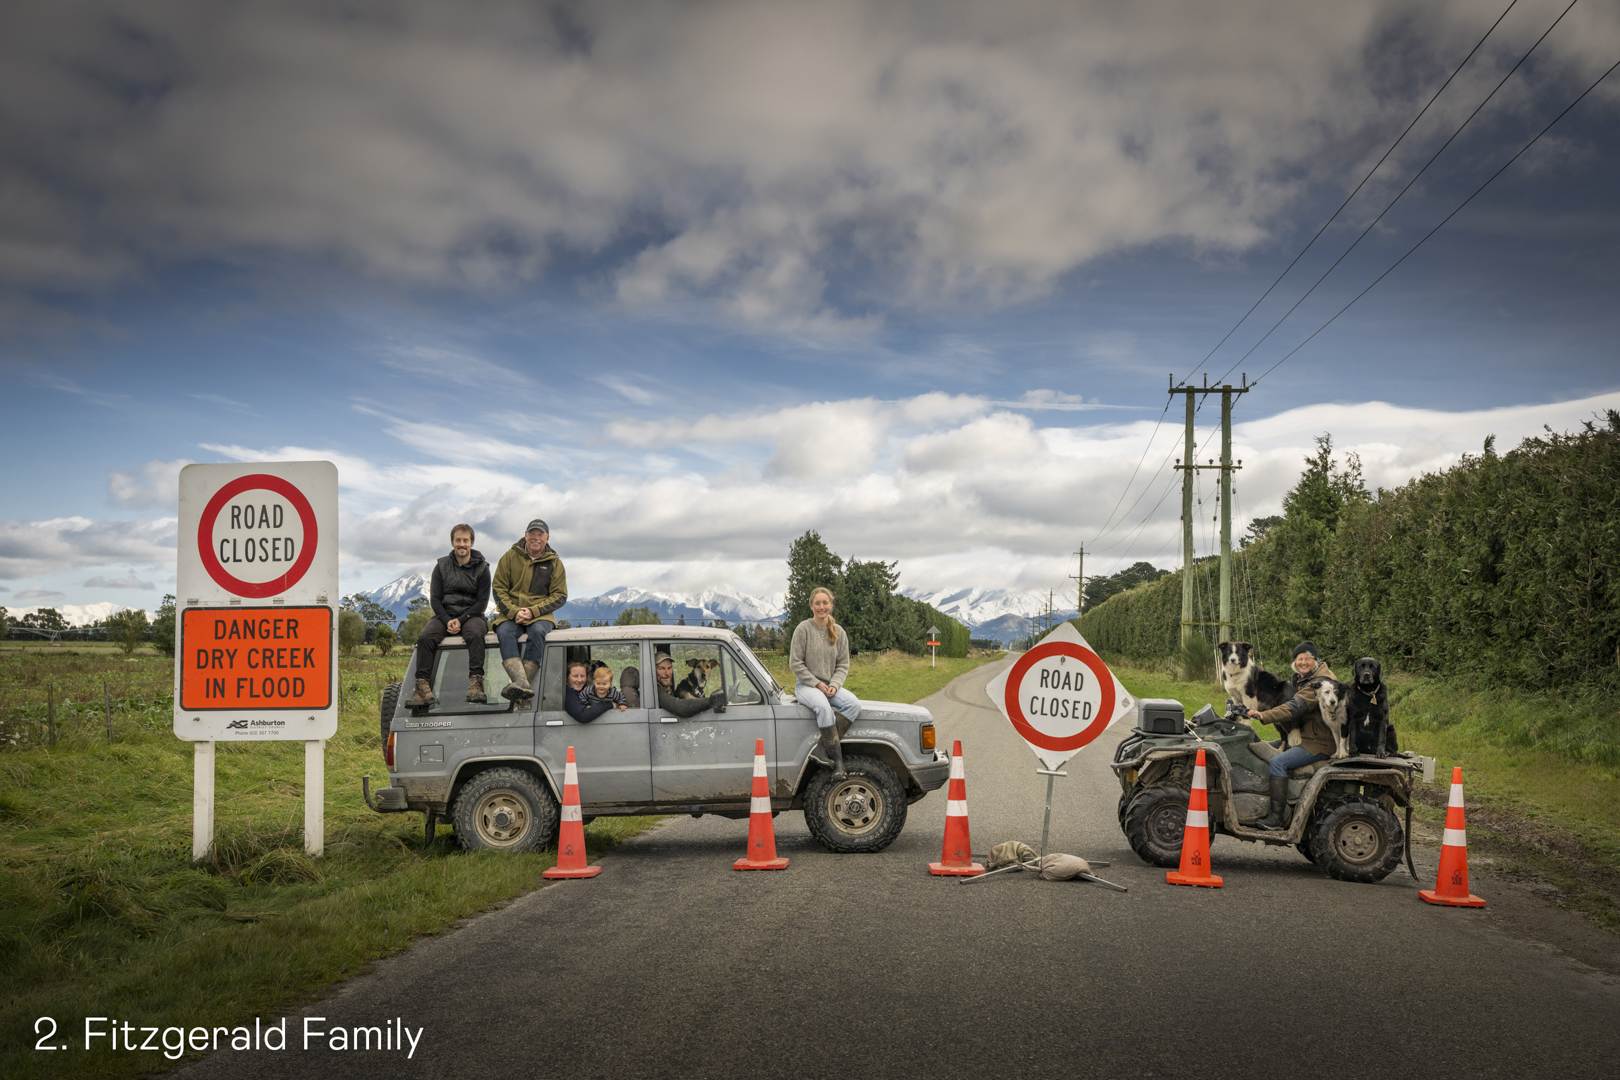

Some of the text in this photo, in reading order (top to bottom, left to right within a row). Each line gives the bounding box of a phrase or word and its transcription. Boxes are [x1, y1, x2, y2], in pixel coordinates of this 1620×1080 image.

[230, 504, 284, 530] ROAD
[219, 537, 295, 564] CLOSED
[214, 618, 299, 640] DANGER
[196, 647, 316, 670] DRY CREEK
[205, 677, 305, 699] IN FLOOD
[1040, 668, 1084, 692] ROAD
[1030, 695, 1092, 721] CLOSED
